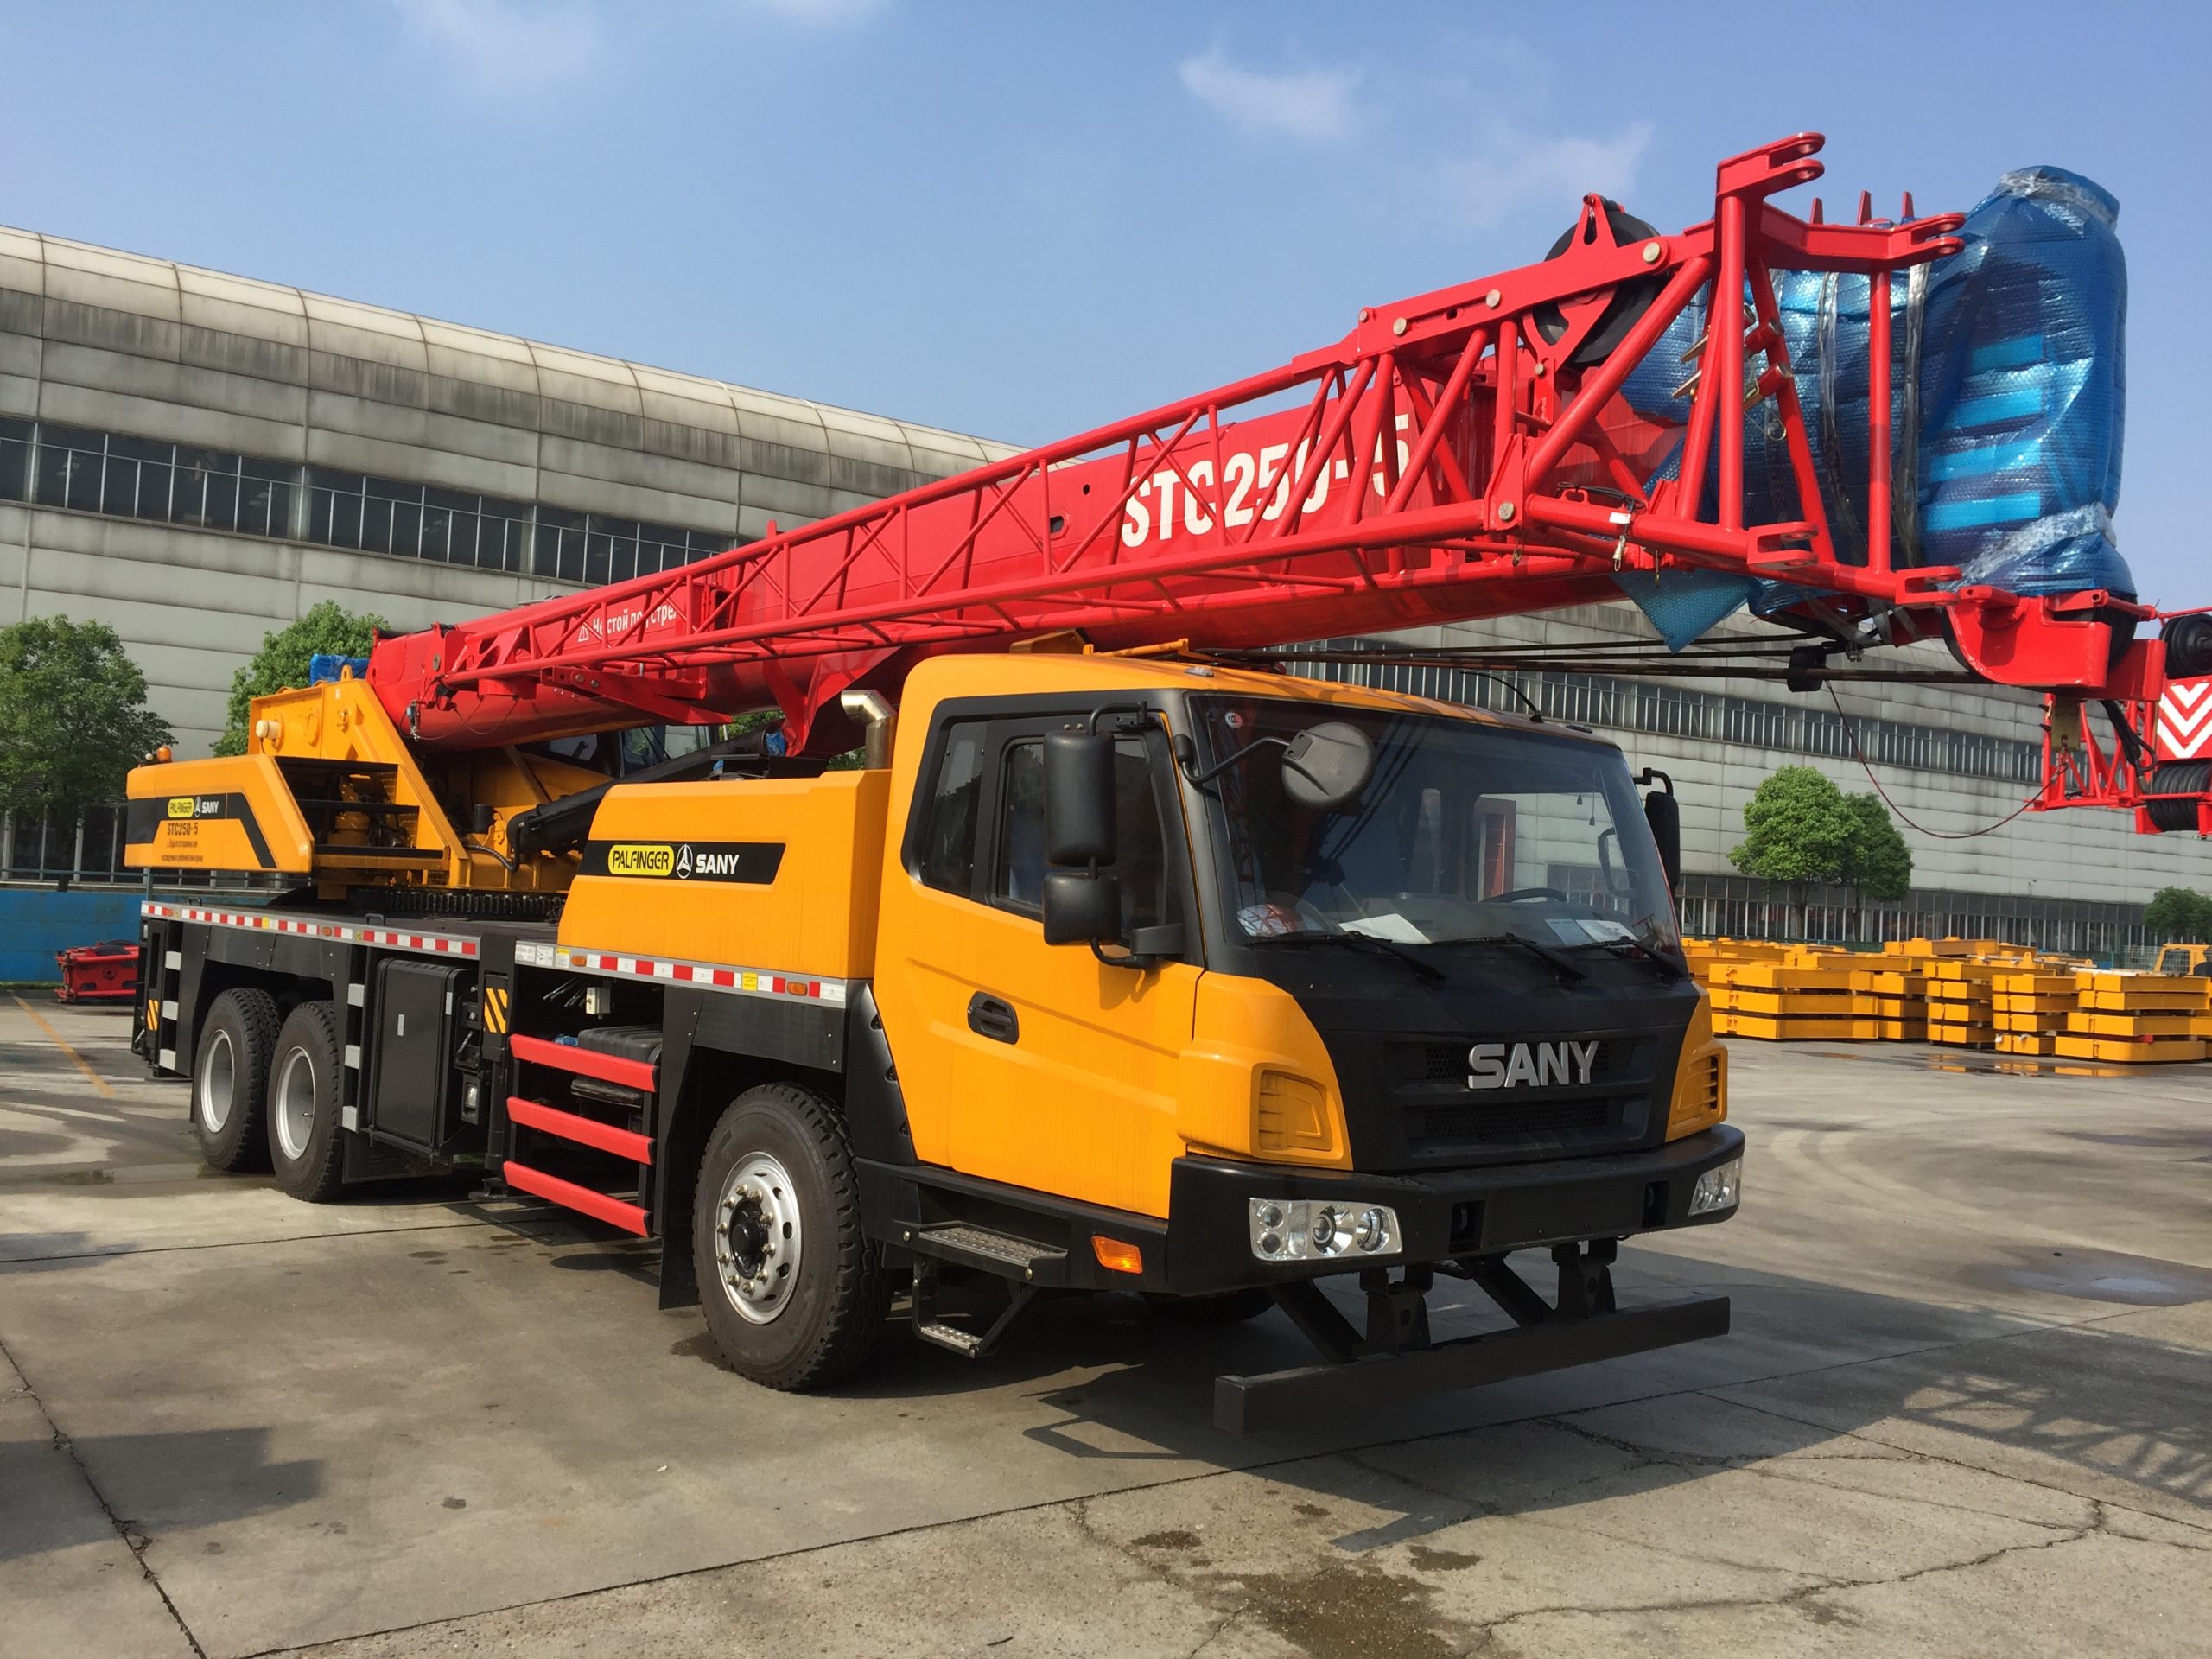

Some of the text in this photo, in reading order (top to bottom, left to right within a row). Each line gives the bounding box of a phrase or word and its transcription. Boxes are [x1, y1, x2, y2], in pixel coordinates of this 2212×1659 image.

[201, 801, 219, 814] SANY
[167, 822, 199, 836] STC250-5
[613, 850, 741, 874] PALFINGER SANY
[1467, 1040, 1599, 1089] SANY
